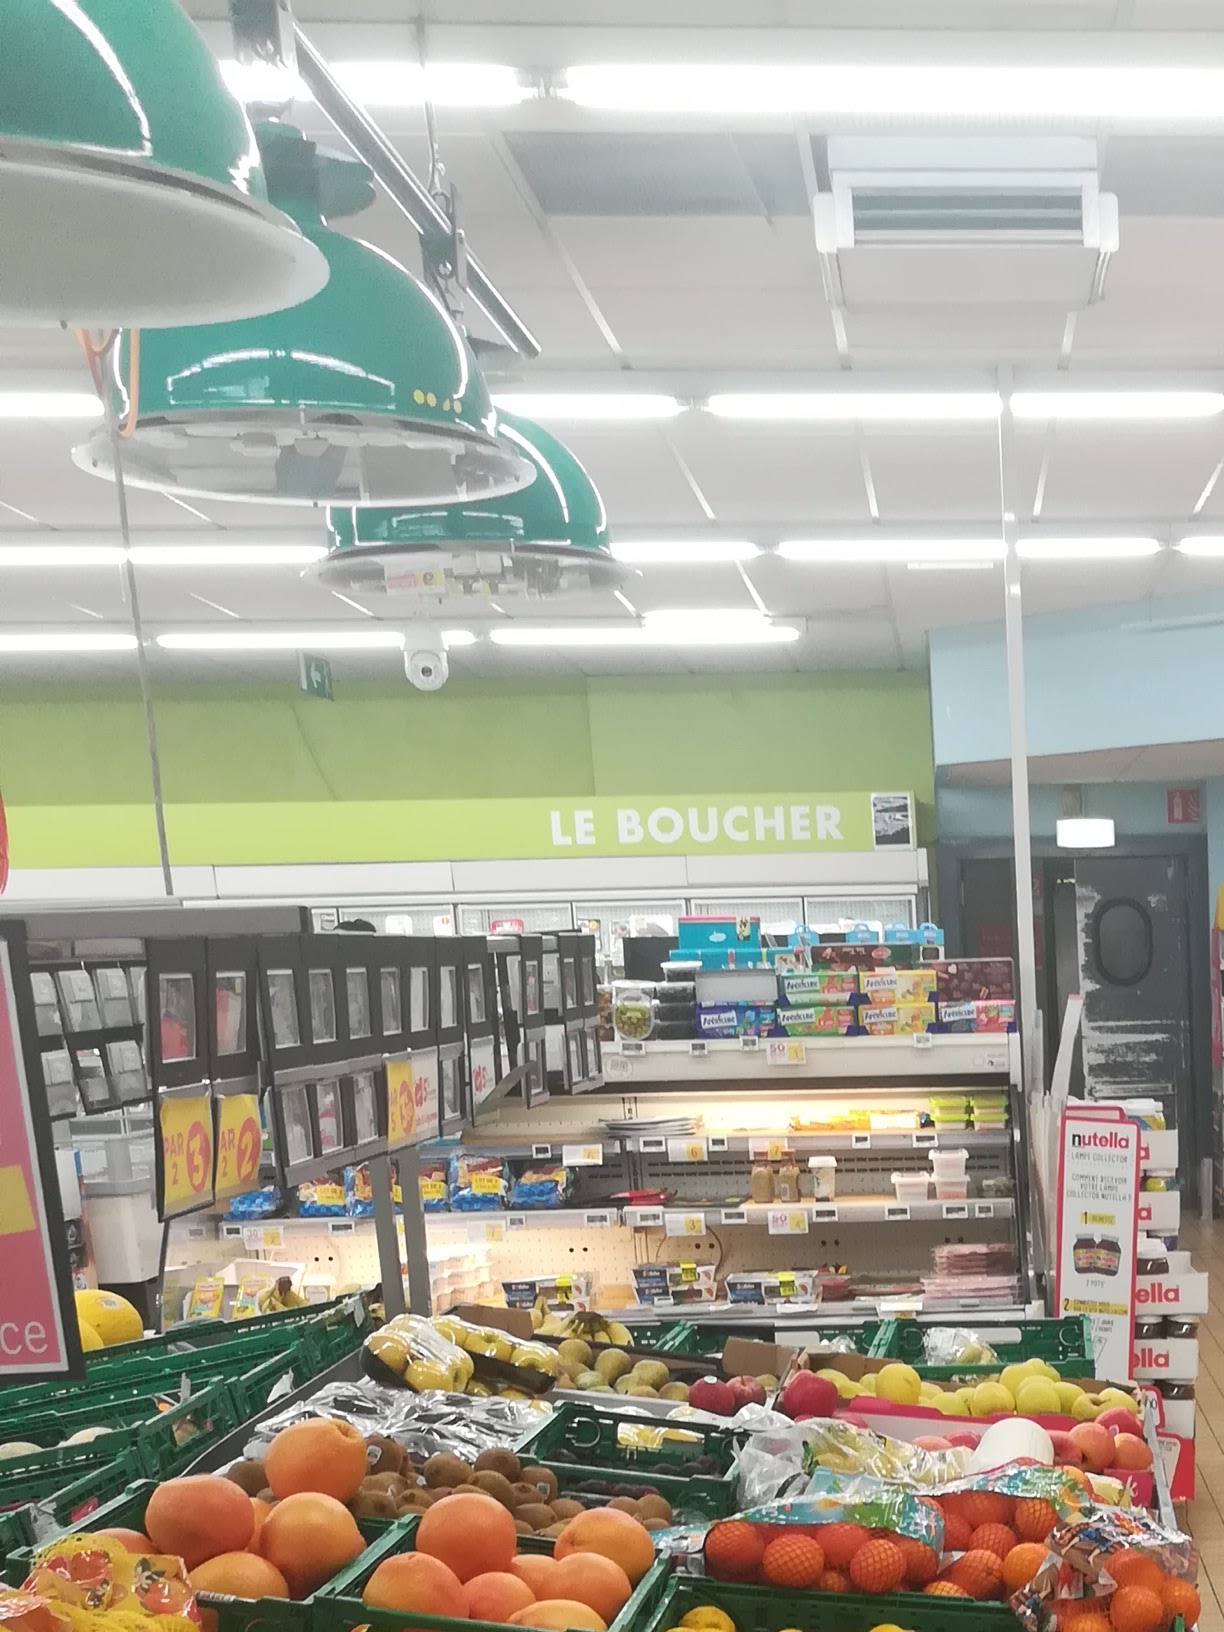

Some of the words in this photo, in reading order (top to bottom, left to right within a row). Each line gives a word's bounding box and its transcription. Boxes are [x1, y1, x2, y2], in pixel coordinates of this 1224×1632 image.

[550, 809, 596, 845] LE
[616, 804, 844, 843] BOUCHER
[164, 1132, 184, 1158] PAR
[219, 1128, 235, 1150] AR
[1072, 1132, 1129, 1149] nutella
[1093, 1153, 1128, 1163] COLLECTOR
[1135, 1282, 1180, 1303] ella
